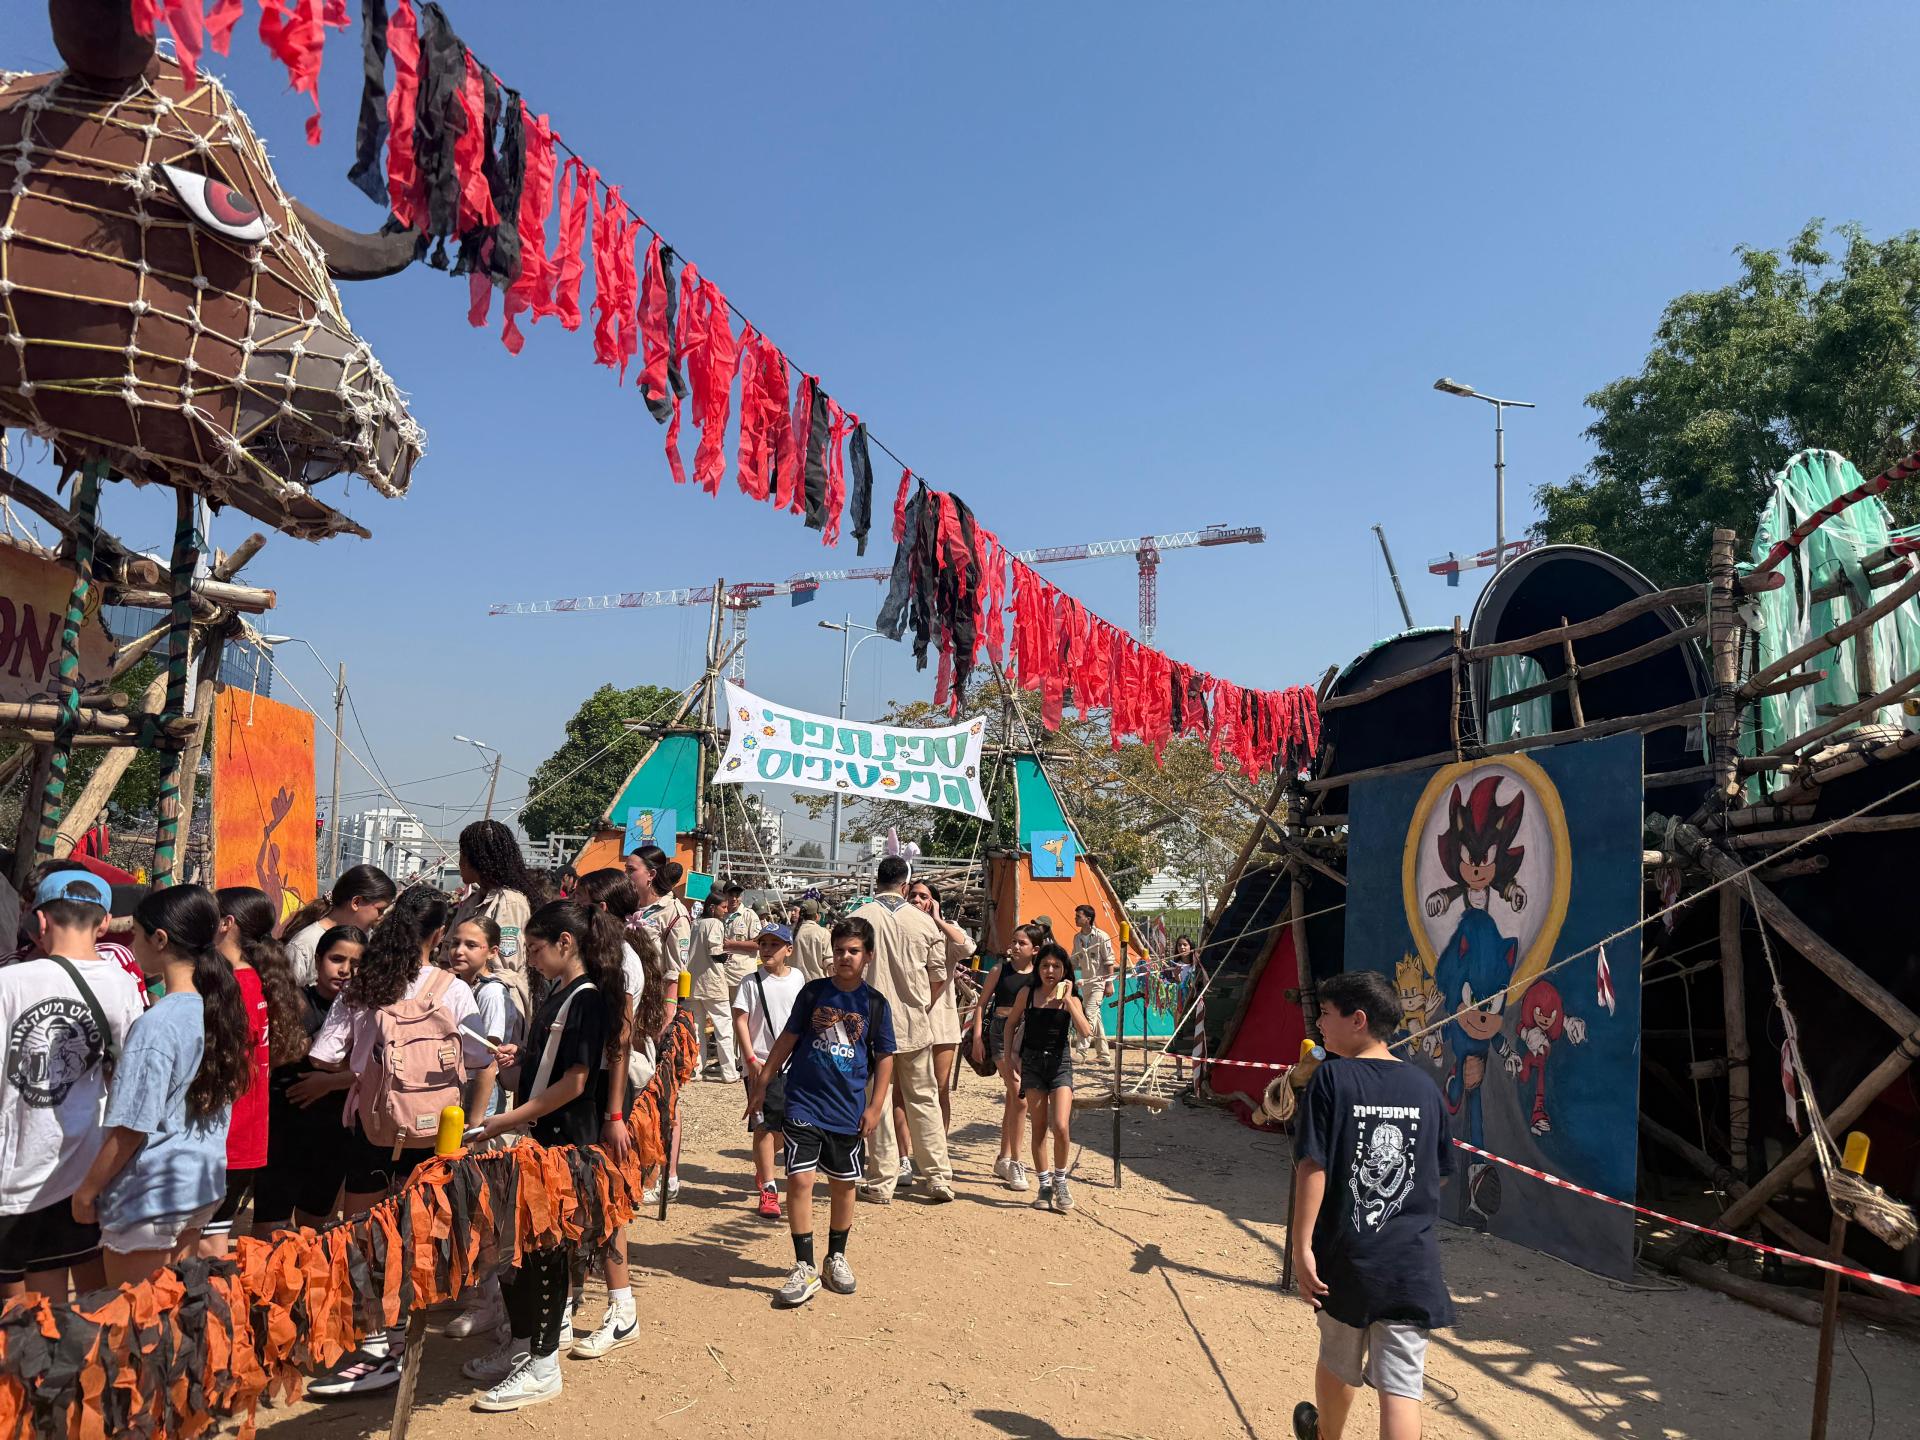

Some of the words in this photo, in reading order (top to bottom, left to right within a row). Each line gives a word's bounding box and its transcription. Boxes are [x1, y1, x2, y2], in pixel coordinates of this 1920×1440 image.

[762, 708, 835, 751] פרי
[835, 727, 968, 769] ספינת
[756, 748, 977, 813] הפלטיפוס
[11, 1001, 64, 1052] משקאות
[812, 1037, 855, 1058] adidas
[1353, 1104, 1421, 1119] אימפריית
